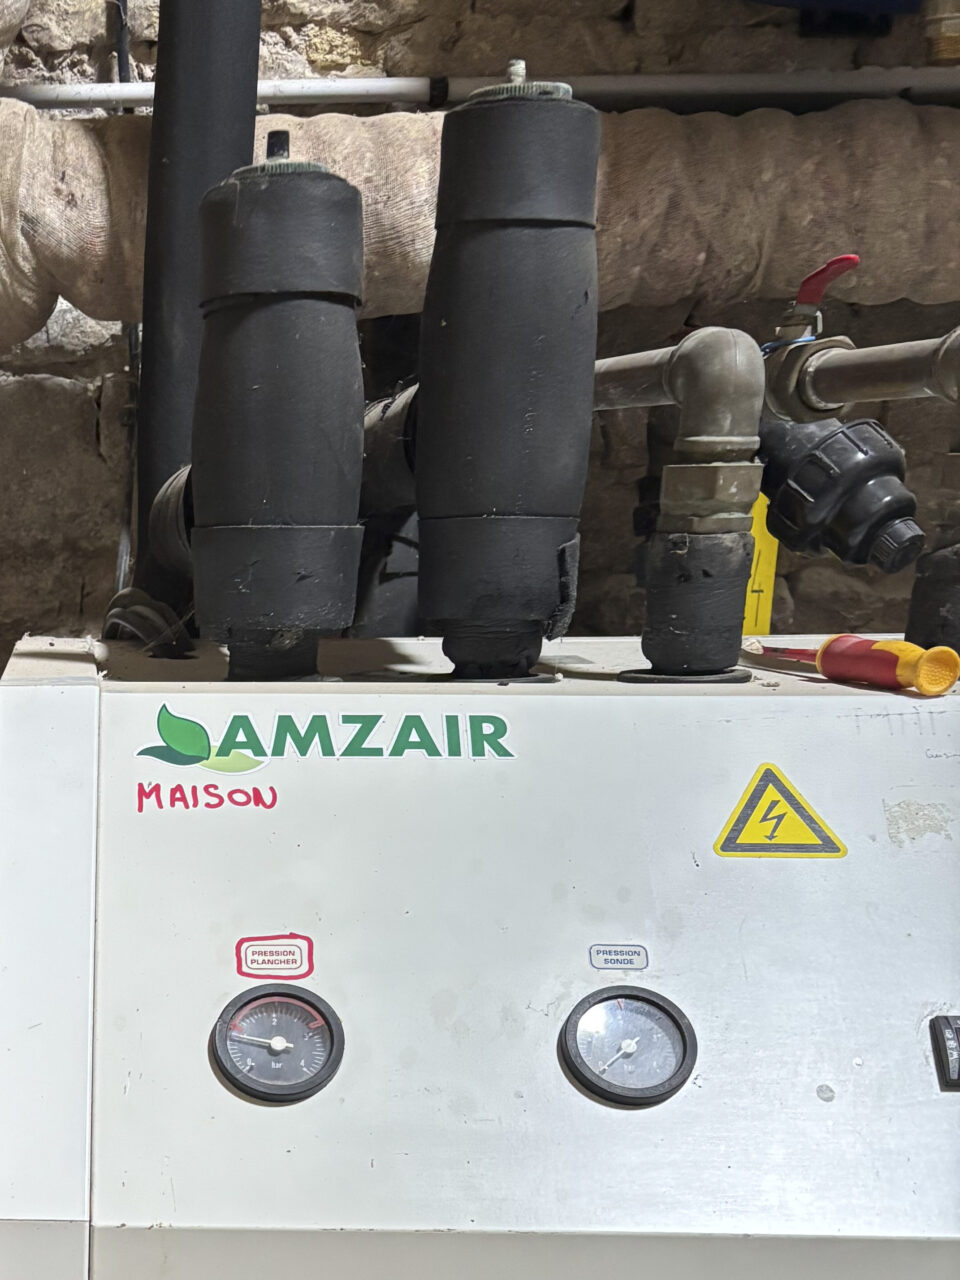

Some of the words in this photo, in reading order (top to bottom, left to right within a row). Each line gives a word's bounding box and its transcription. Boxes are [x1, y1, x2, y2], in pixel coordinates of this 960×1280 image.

[215, 714, 515, 757] AMZAIR
[137, 782, 277, 813] MAISON
[596, 949, 641, 957] PRESSION
[250, 958, 298, 966] PLANCHER
[271, 1061, 283, 1069] bar
